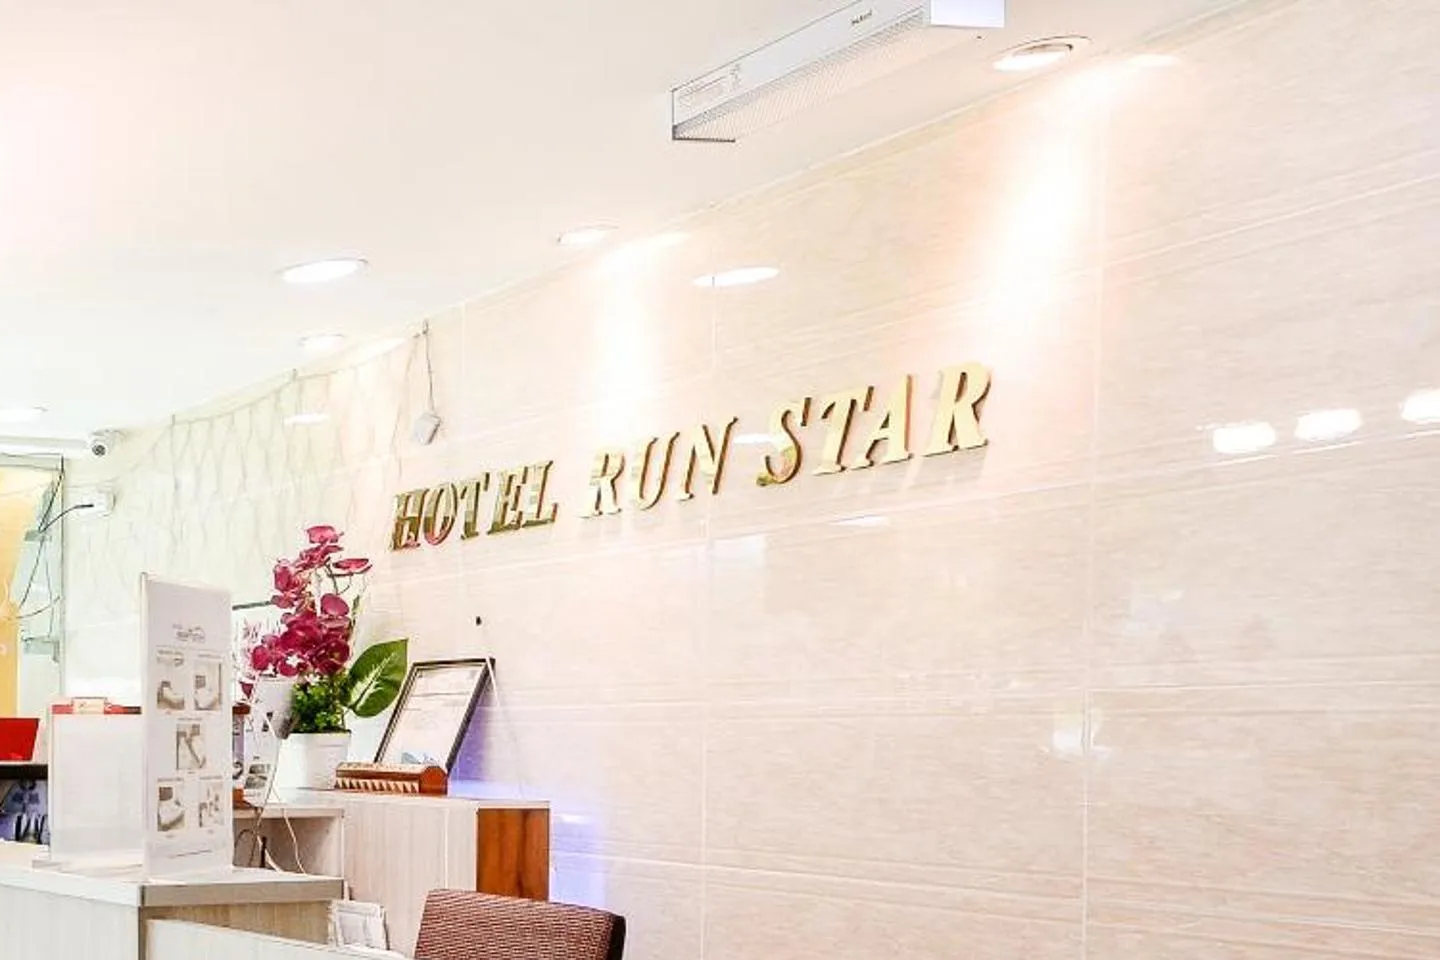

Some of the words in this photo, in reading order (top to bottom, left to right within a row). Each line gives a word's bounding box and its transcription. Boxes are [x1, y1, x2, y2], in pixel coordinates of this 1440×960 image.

[391, 460, 558, 550] HOTEL
[580, 416, 739, 518] RUN
[756, 361, 994, 486] STAR
